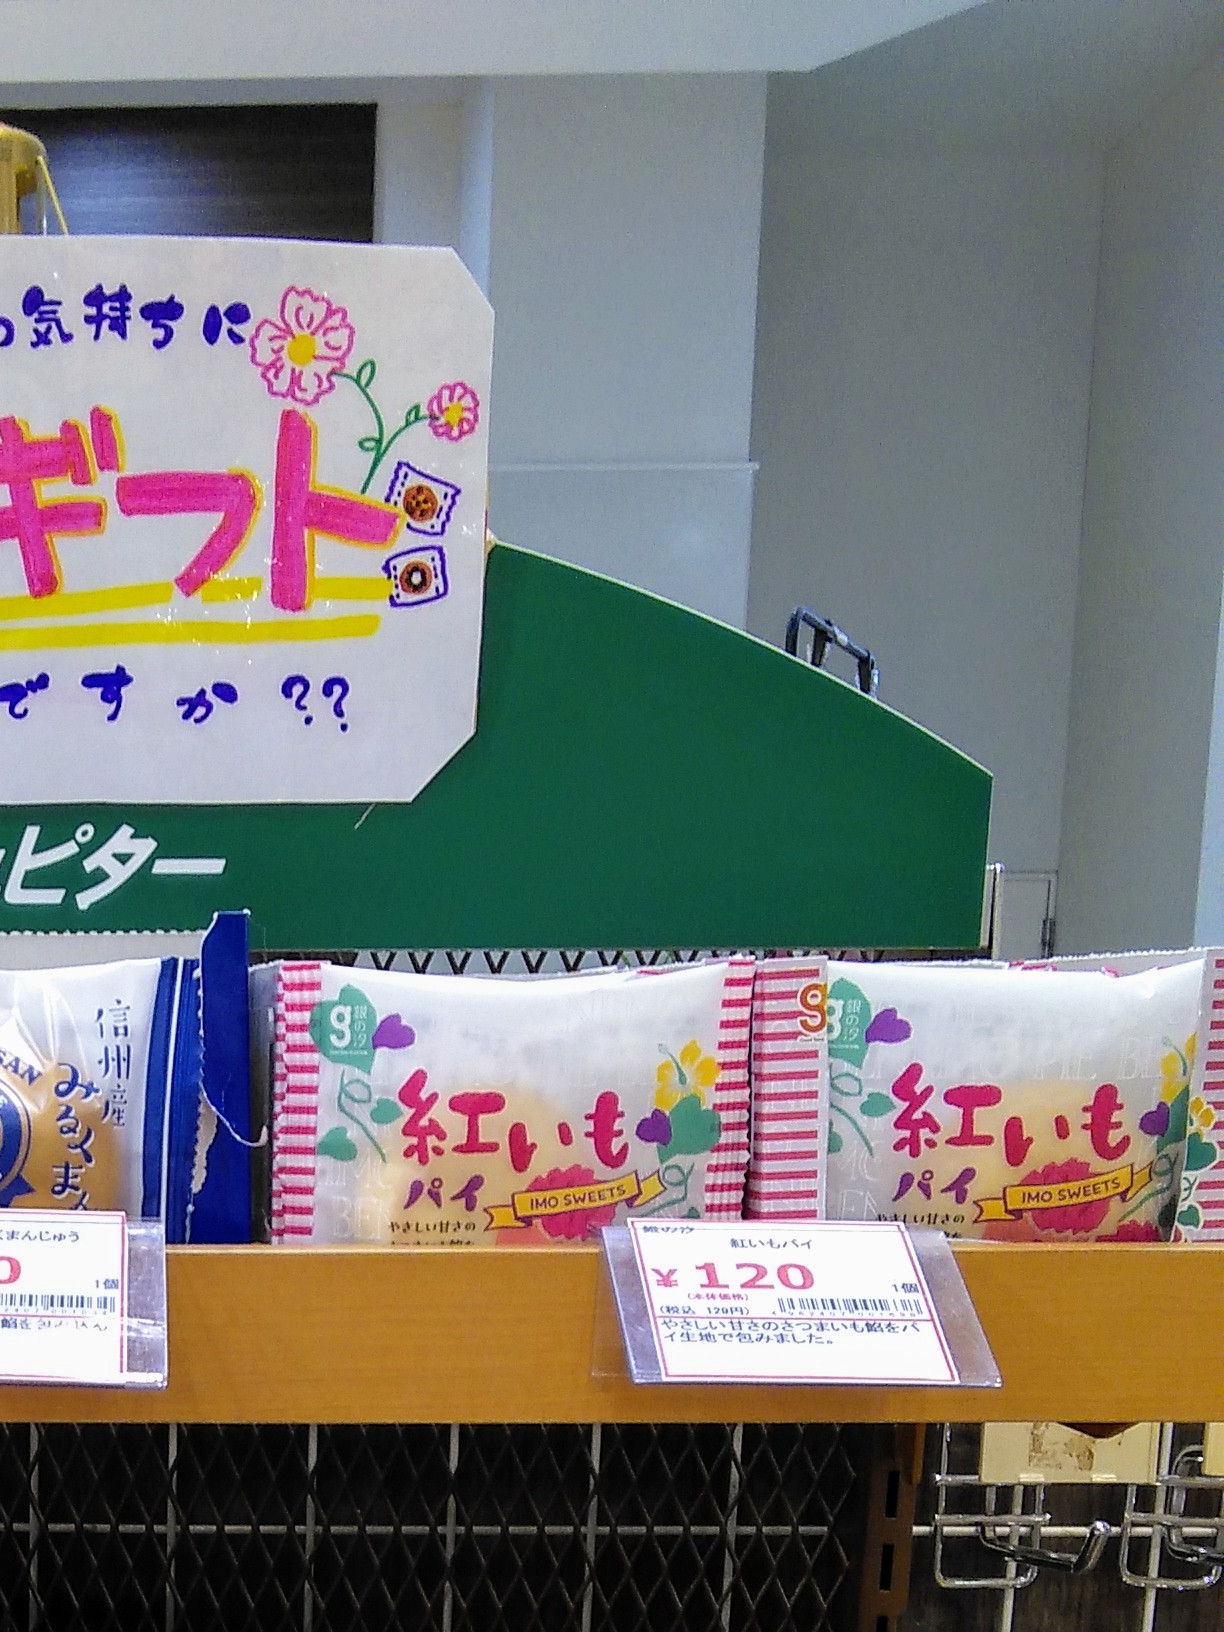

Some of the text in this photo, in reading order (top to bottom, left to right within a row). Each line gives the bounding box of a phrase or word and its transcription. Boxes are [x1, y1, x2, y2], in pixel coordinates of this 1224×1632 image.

[397, 1068, 630, 1173] 紅いも
[892, 1062, 1131, 1167] 紅いも
[403, 1174, 484, 1211] パイ
[529, 1184, 626, 1210] IMO SWEETS
[893, 1167, 976, 1204] パイ
[1021, 1177, 1120, 1205] IMO SWEETS
[730, 1238, 813, 1250] 紅いもパイ
[95, 1279, 119, 1290] 1個
[891, 1283, 919, 1293] 1個
[663, 1332, 835, 1344] イ生地で包みました。
